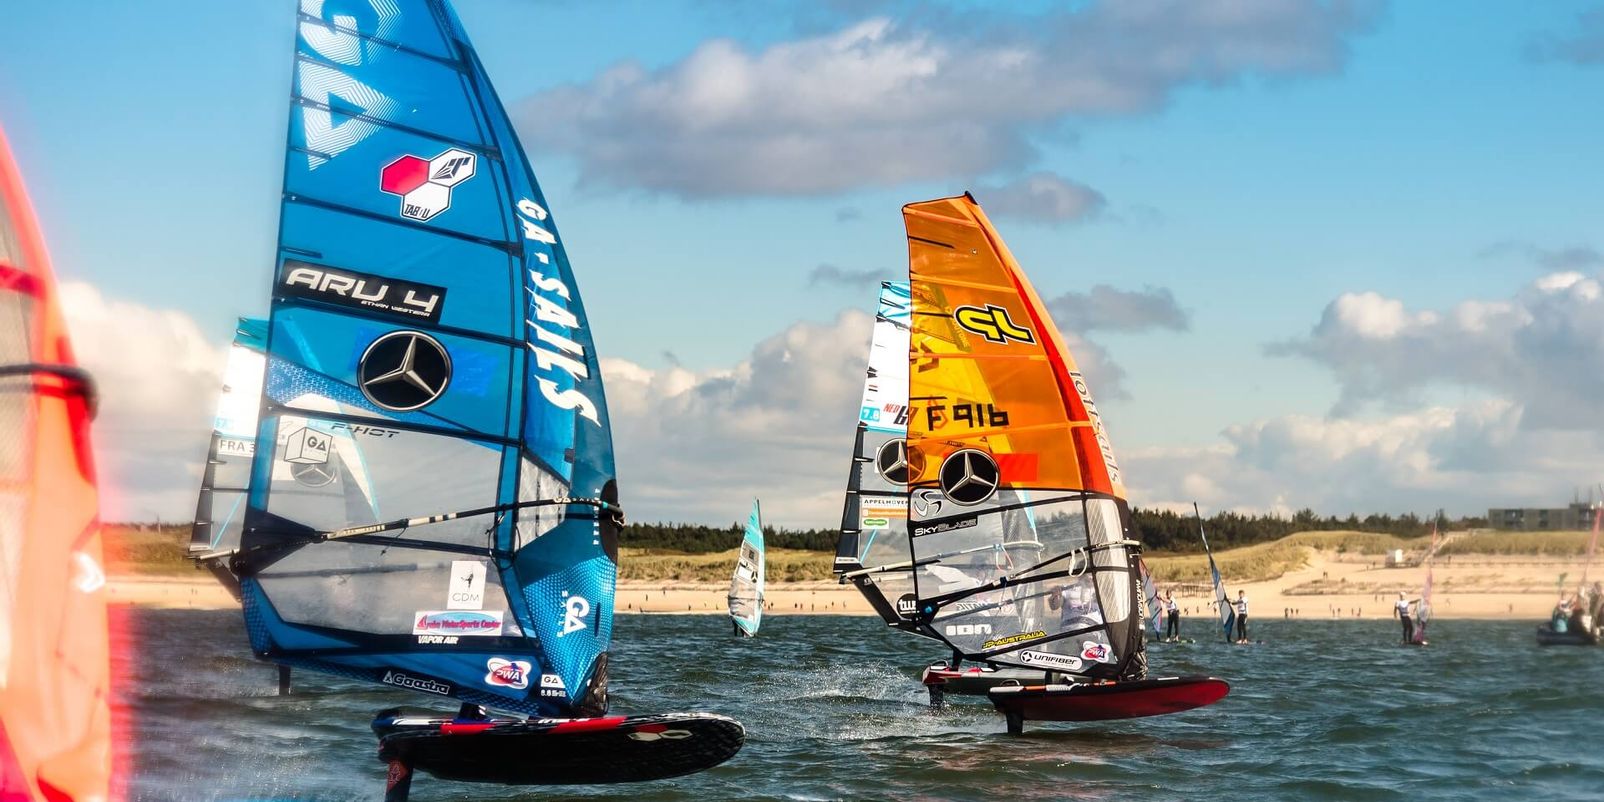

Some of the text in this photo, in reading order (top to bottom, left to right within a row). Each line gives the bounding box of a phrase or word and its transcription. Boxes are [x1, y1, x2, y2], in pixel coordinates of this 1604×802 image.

[286, 268, 439, 313] ARU 4
[220, 440, 245, 452] FRA
[452, 592, 480, 602] CDM
[418, 635, 459, 645] VAPOR AIR
